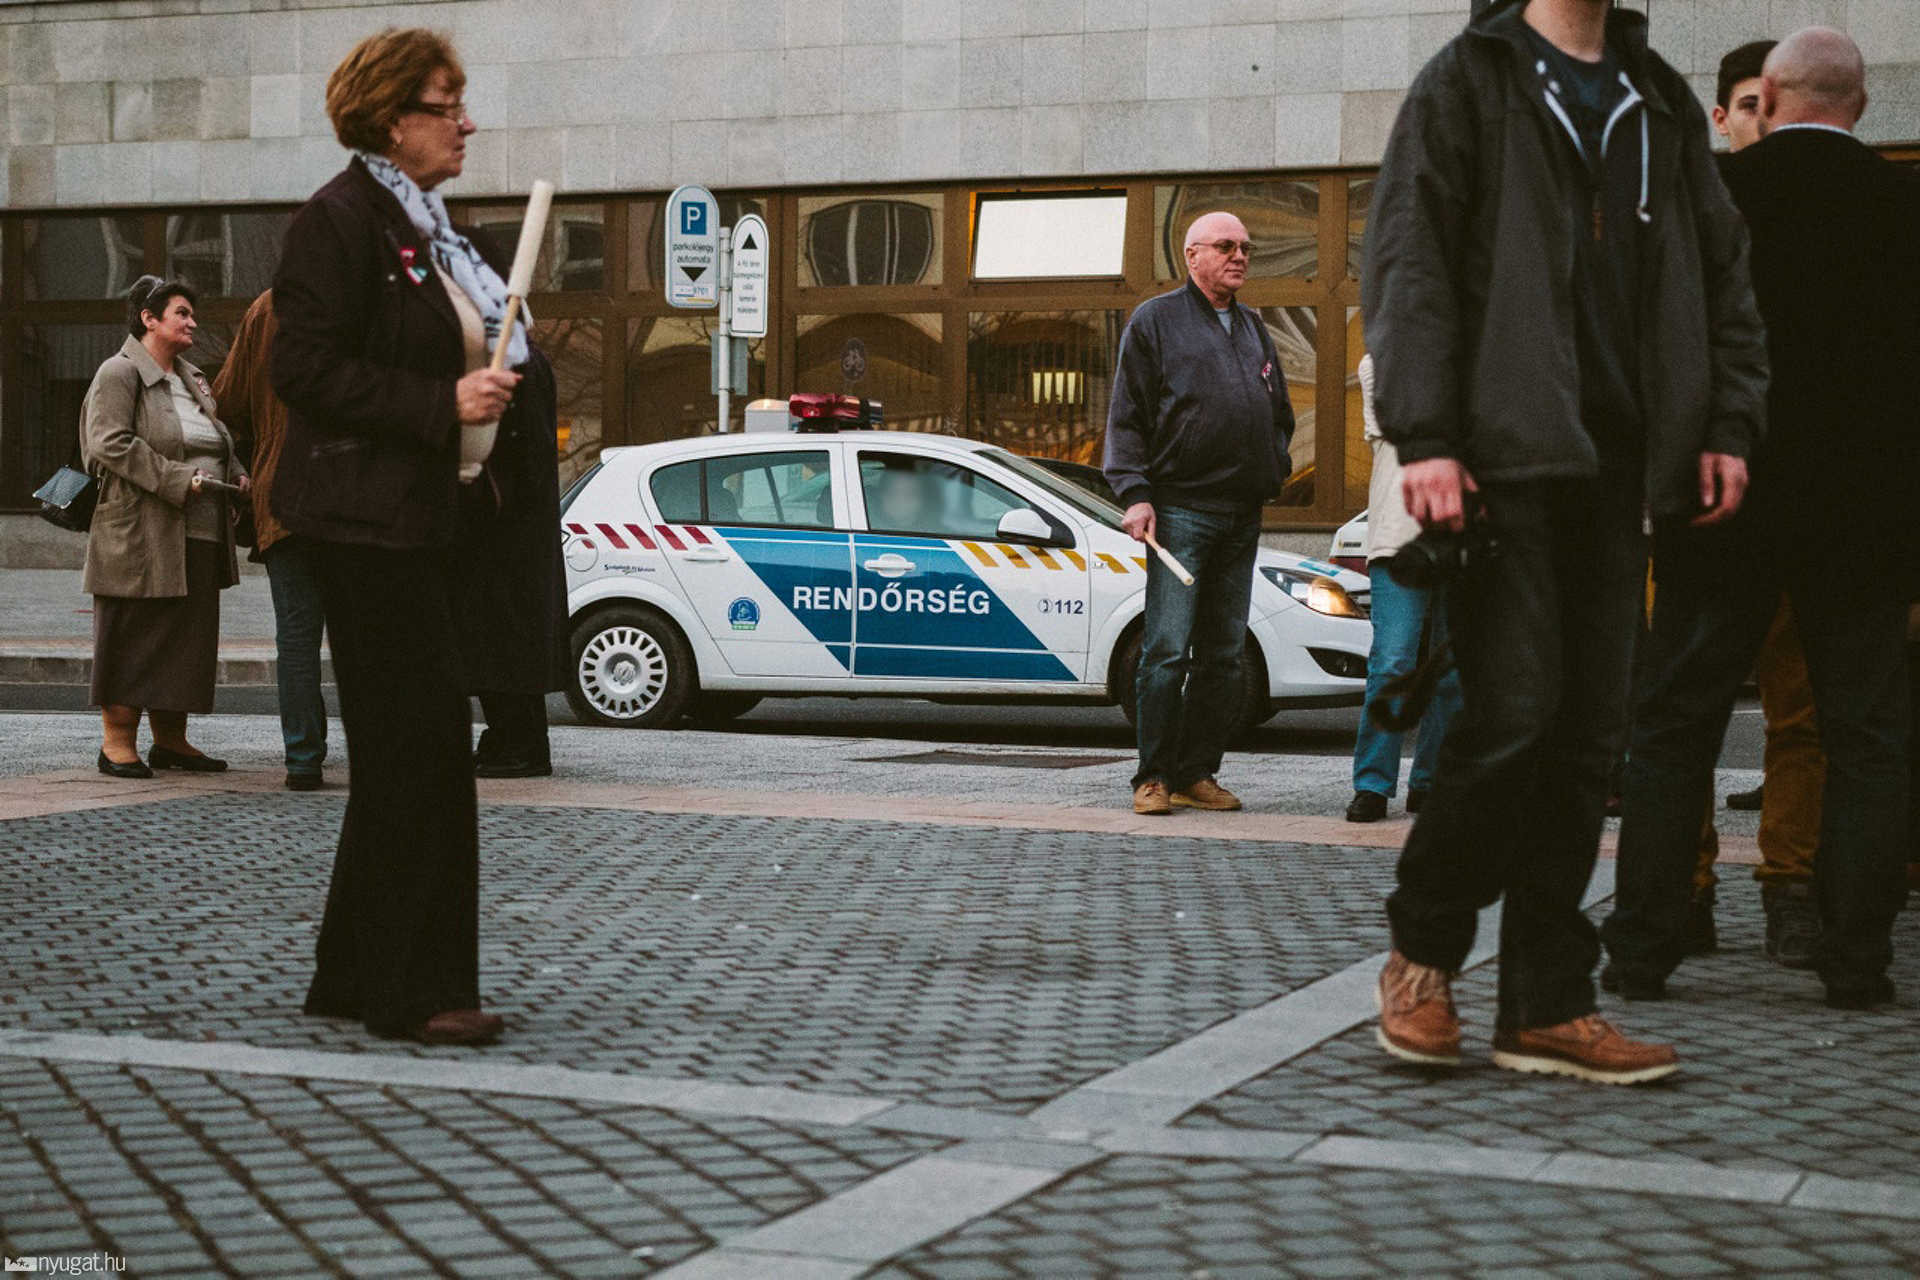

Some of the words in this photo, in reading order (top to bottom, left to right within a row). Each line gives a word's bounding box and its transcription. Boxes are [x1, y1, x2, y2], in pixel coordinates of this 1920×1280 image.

[686, 206, 701, 231] P
[676, 254, 711, 264] automata
[793, 582, 991, 615] RENDŐRSÉG
[1054, 599, 1084, 615] 112
